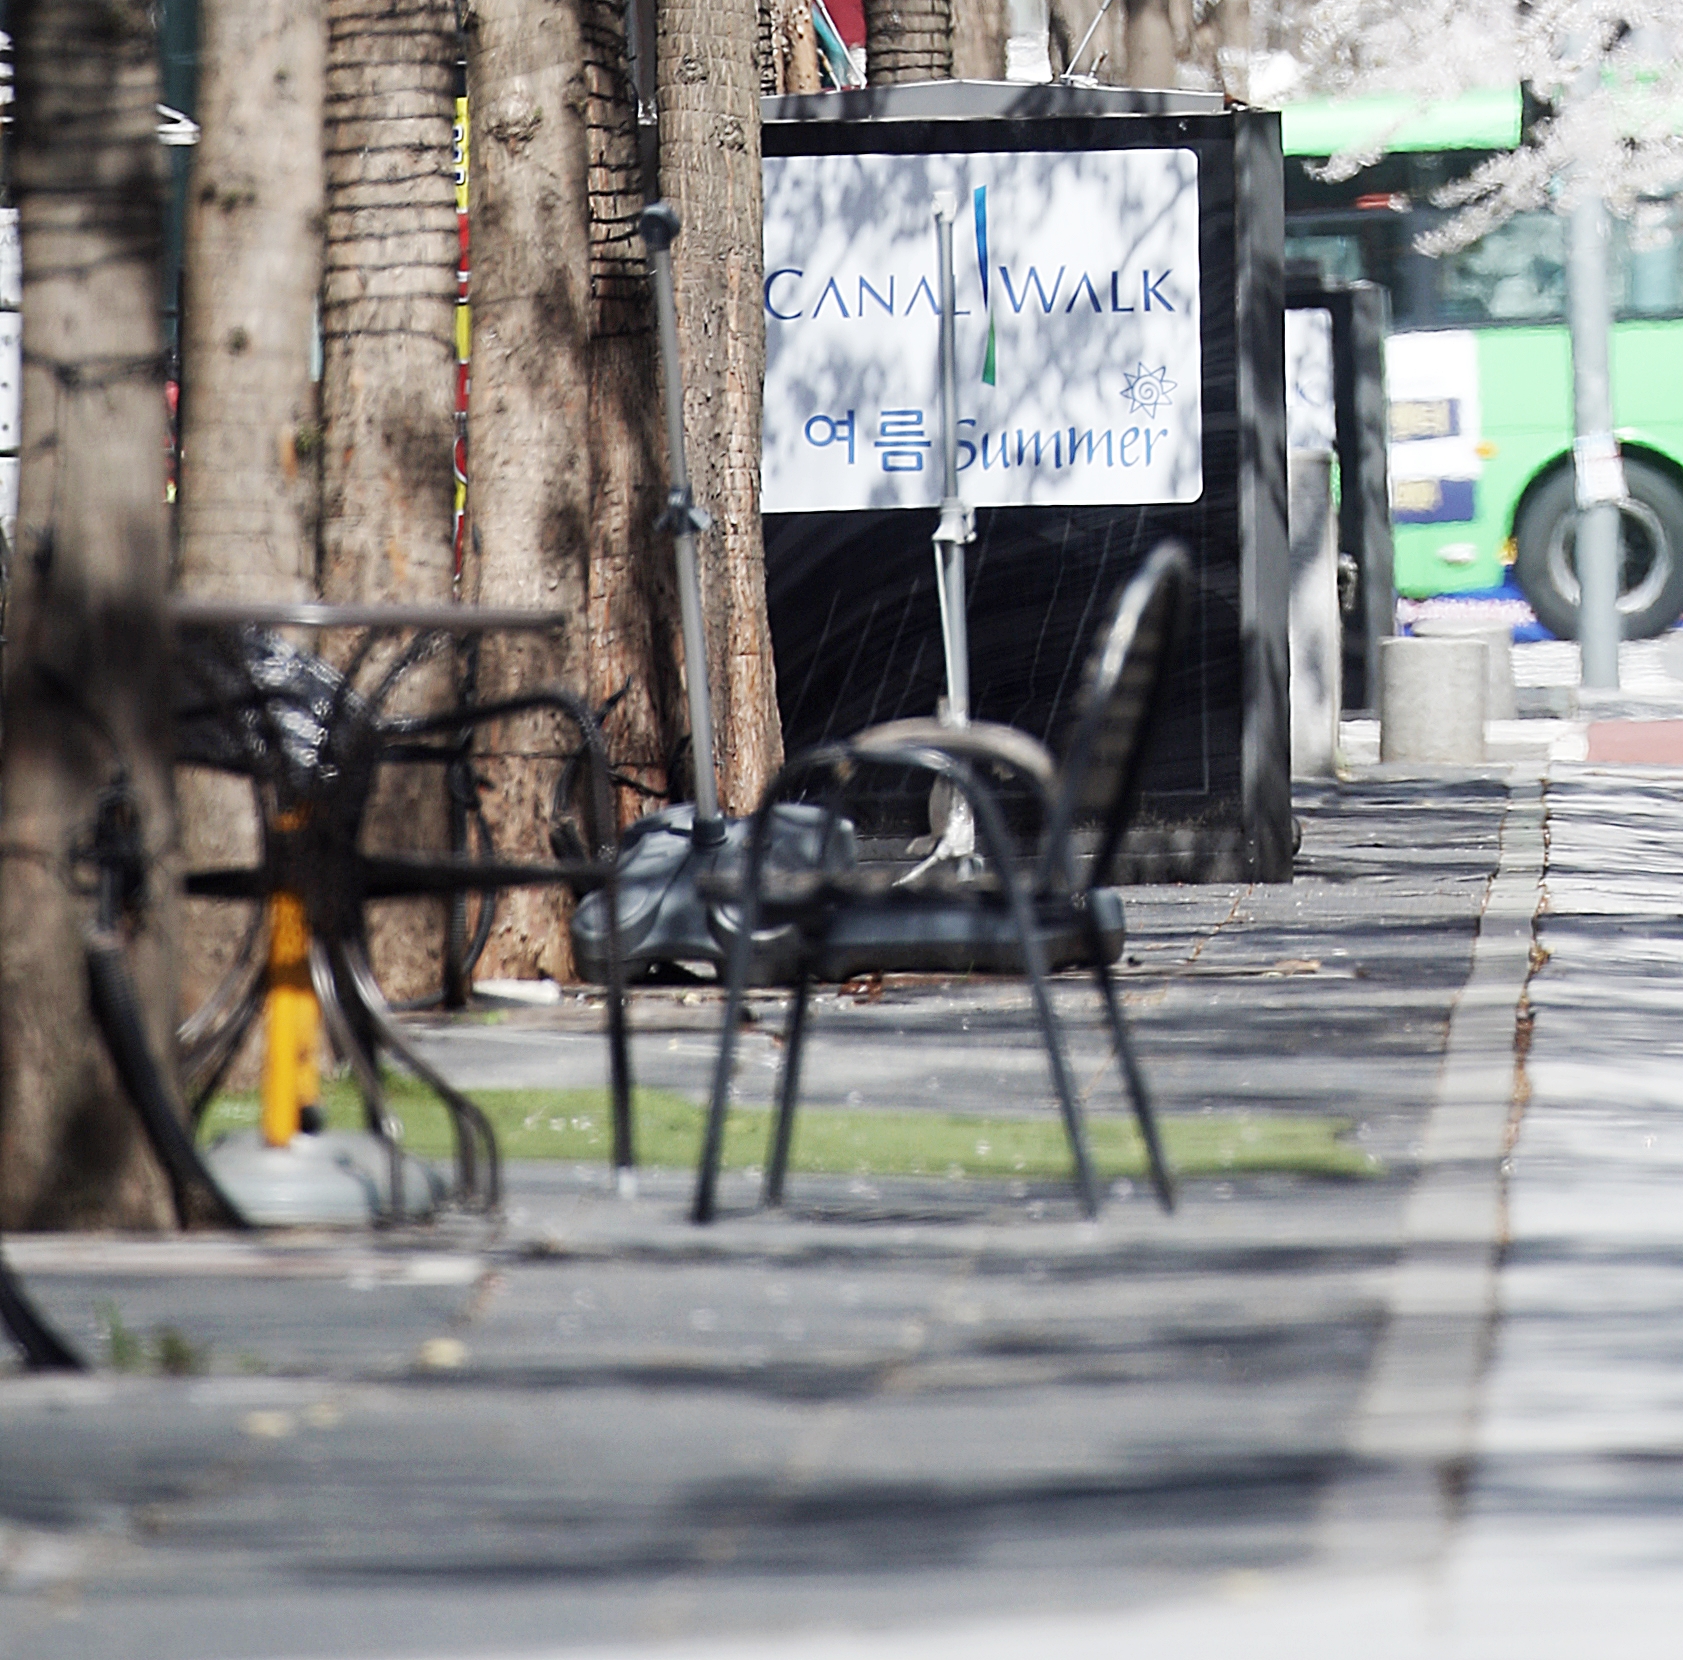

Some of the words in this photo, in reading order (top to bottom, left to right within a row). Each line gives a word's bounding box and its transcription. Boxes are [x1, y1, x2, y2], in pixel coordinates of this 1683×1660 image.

[1000, 265, 1176, 314] WALK
[804, 409, 932, 473] 여름
[956, 418, 1169, 473] Summer
